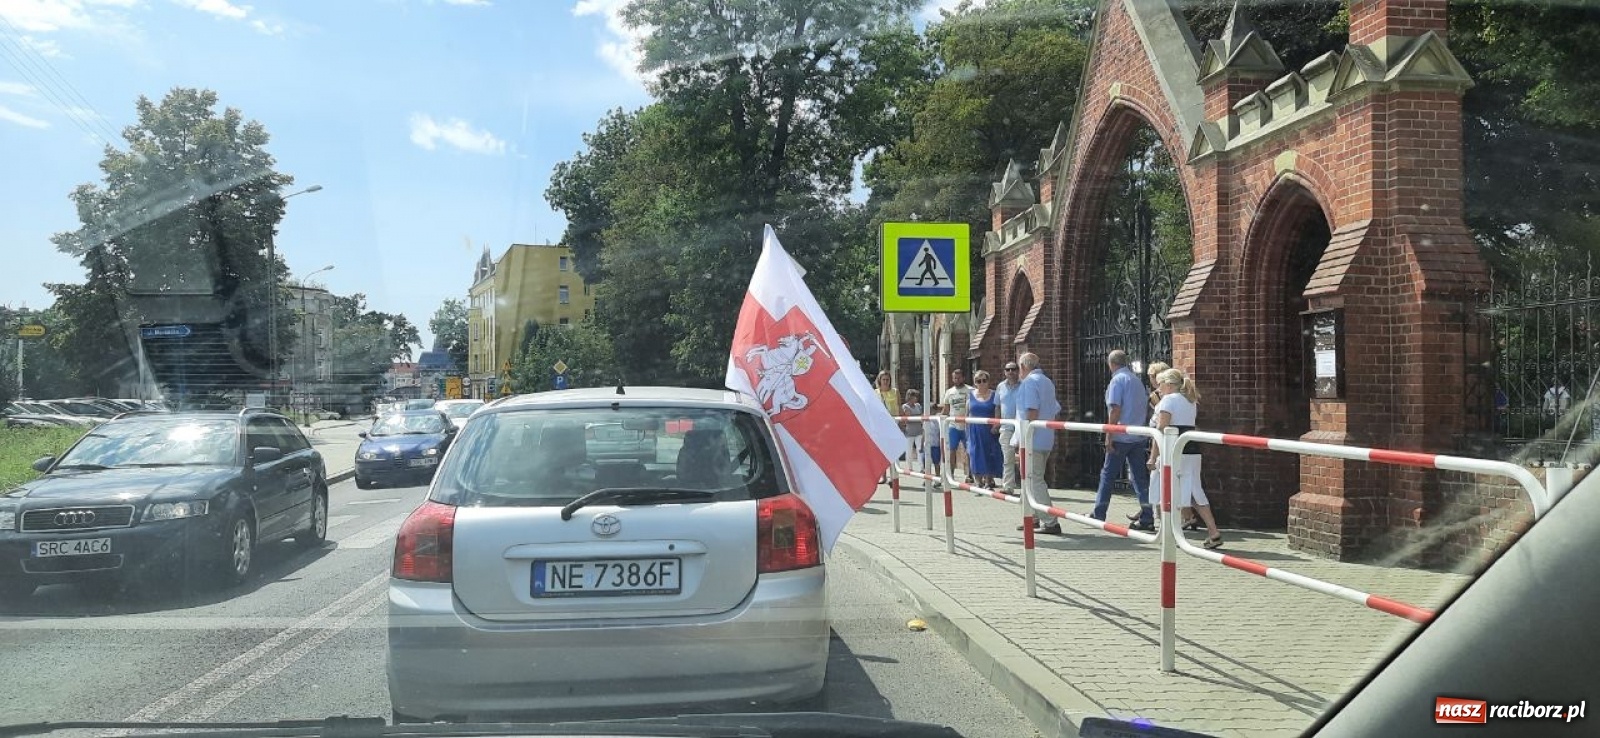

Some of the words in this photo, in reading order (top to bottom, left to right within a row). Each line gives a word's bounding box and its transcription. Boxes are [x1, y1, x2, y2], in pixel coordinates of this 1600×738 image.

[556, 375, 563, 385] P
[39, 542, 69, 555] SRC
[73, 539, 109, 554] 4AC6
[551, 563, 584, 589] NE
[594, 561, 675, 589] 7386F
